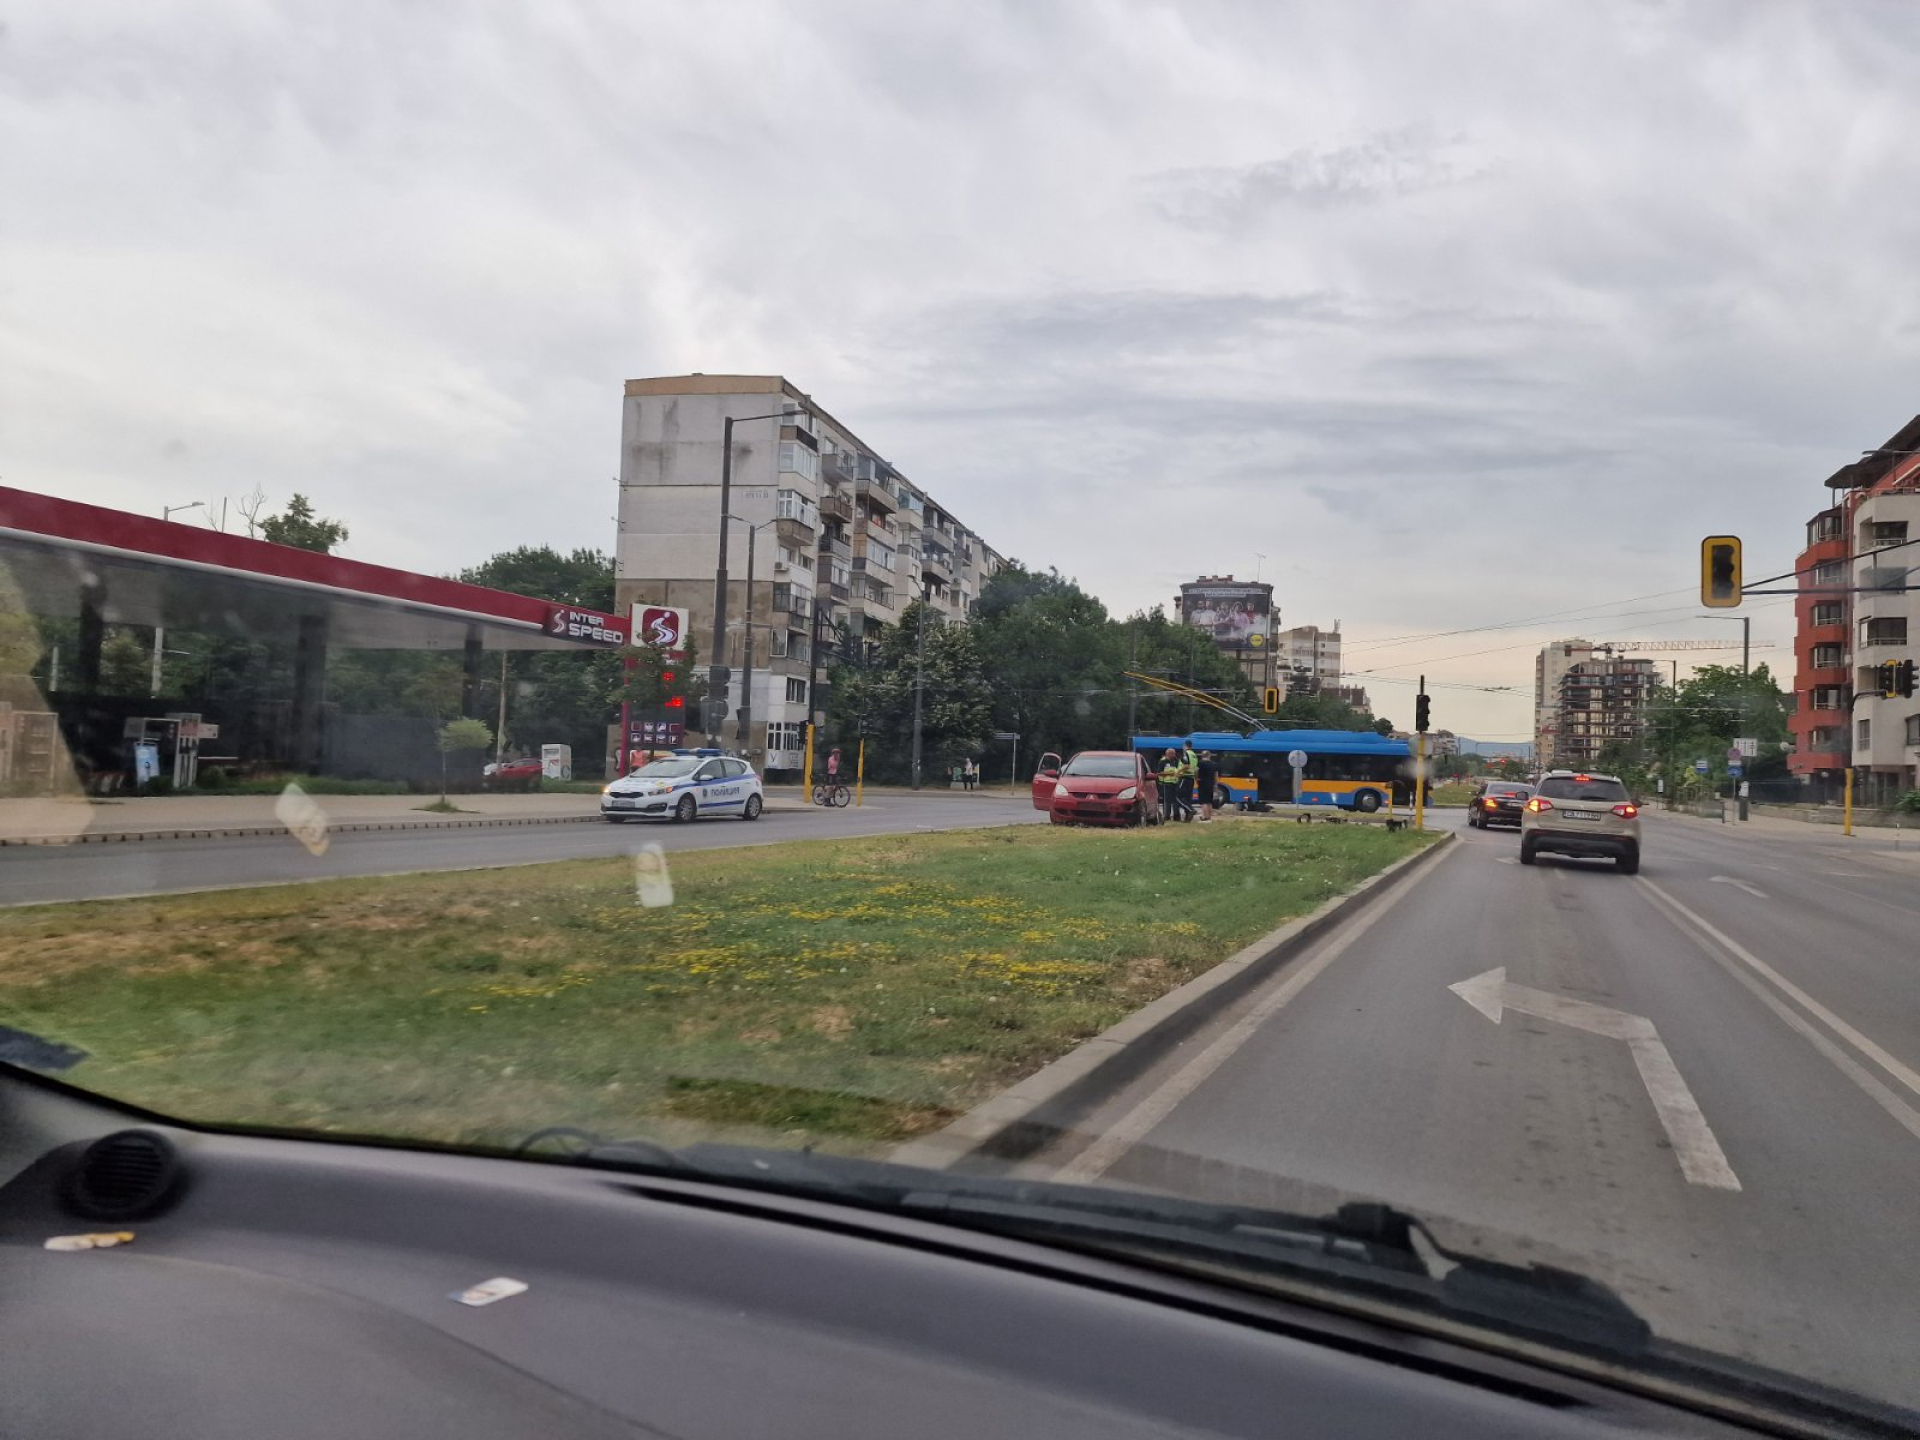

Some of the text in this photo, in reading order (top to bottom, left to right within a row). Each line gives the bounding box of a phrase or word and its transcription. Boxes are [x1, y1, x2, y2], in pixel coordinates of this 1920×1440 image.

[569, 611, 604, 626] INTER
[568, 623, 624, 643] SPEED
[711, 786, 740, 797] ПОЛИЦИЯ
